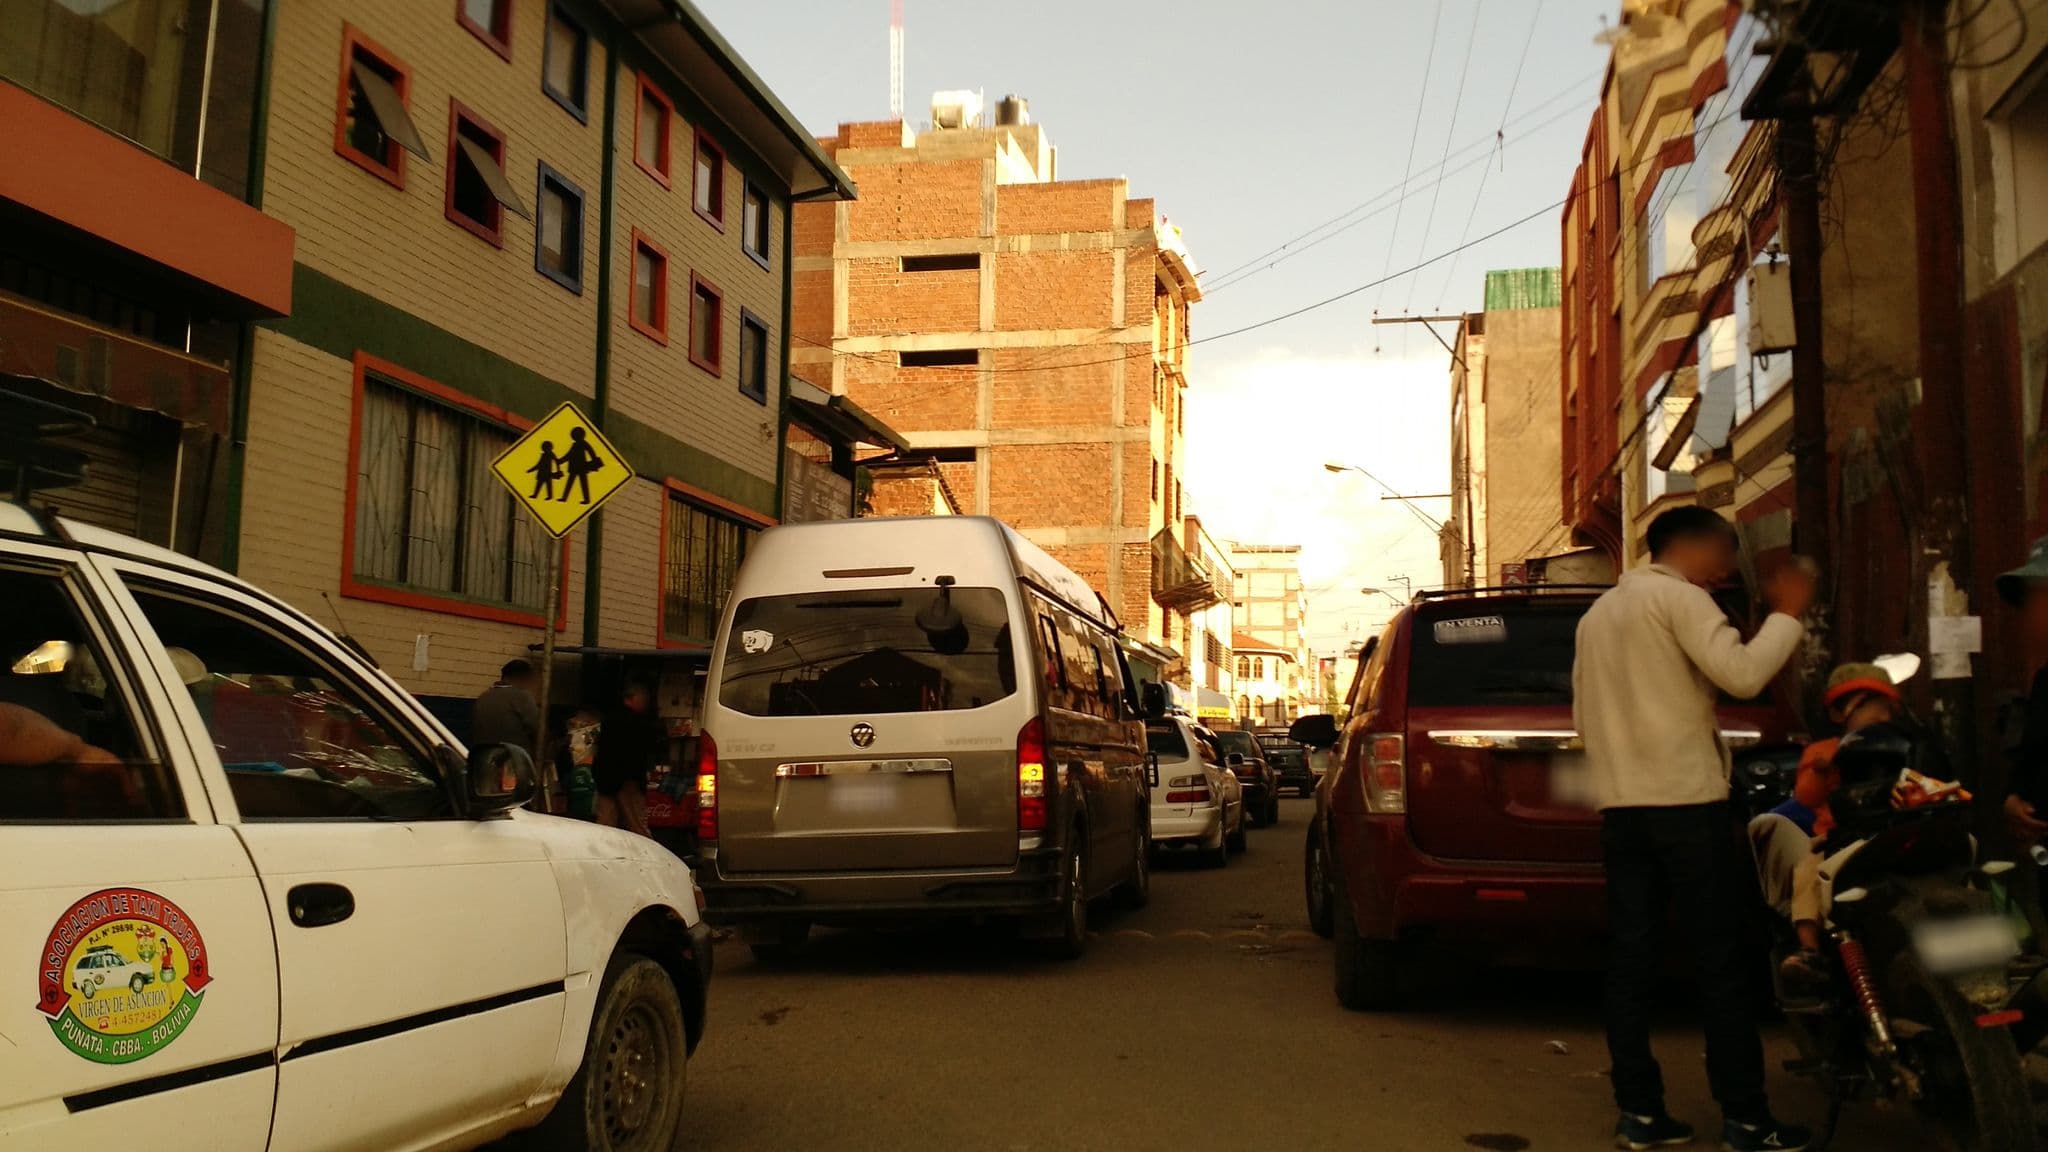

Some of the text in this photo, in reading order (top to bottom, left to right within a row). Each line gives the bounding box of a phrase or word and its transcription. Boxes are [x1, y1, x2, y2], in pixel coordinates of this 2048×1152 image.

[1457, 617, 1501, 628] VENTA
[45, 893, 201, 984] ASOCIACION DE TAXI TRUFIS
[78, 989, 167, 1018] VIRGEN DE ASUNCION
[61, 1018, 104, 1055] PUNATA
[152, 1003, 192, 1044] BOLIVIA
